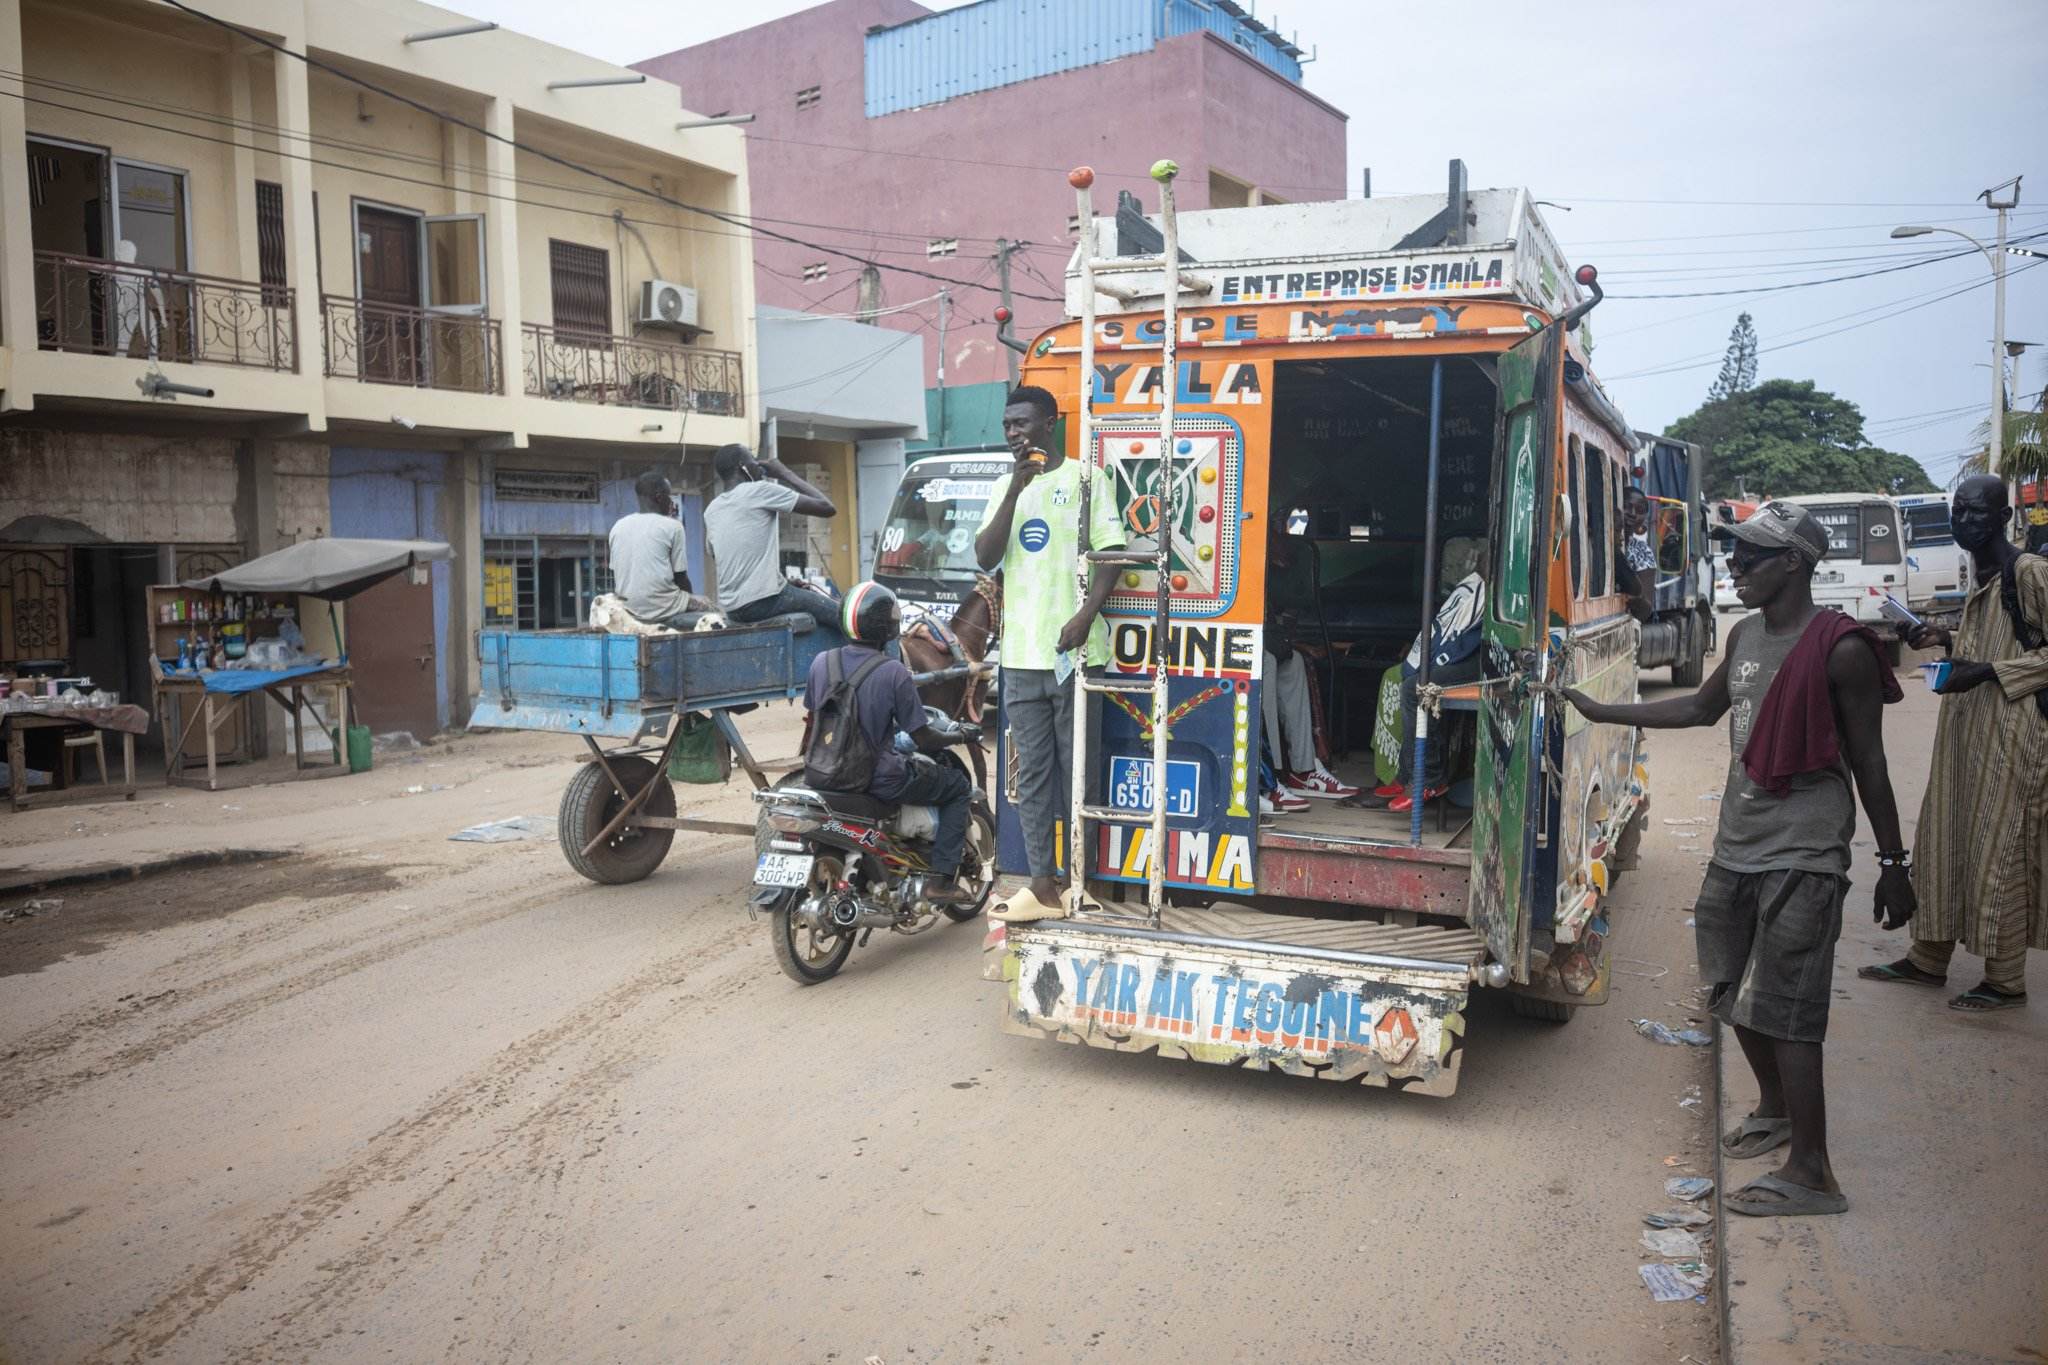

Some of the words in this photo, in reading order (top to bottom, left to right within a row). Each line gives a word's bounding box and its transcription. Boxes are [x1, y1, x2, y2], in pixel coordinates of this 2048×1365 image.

[1221, 265, 1397, 300] ENTREPRISE
[882, 528, 904, 551] 80
[936, 592, 958, 601] TATA
[1117, 783, 1192, 813] 650-D
[1072, 958, 1140, 1025] YAR
[1144, 966, 1200, 1034] AK
